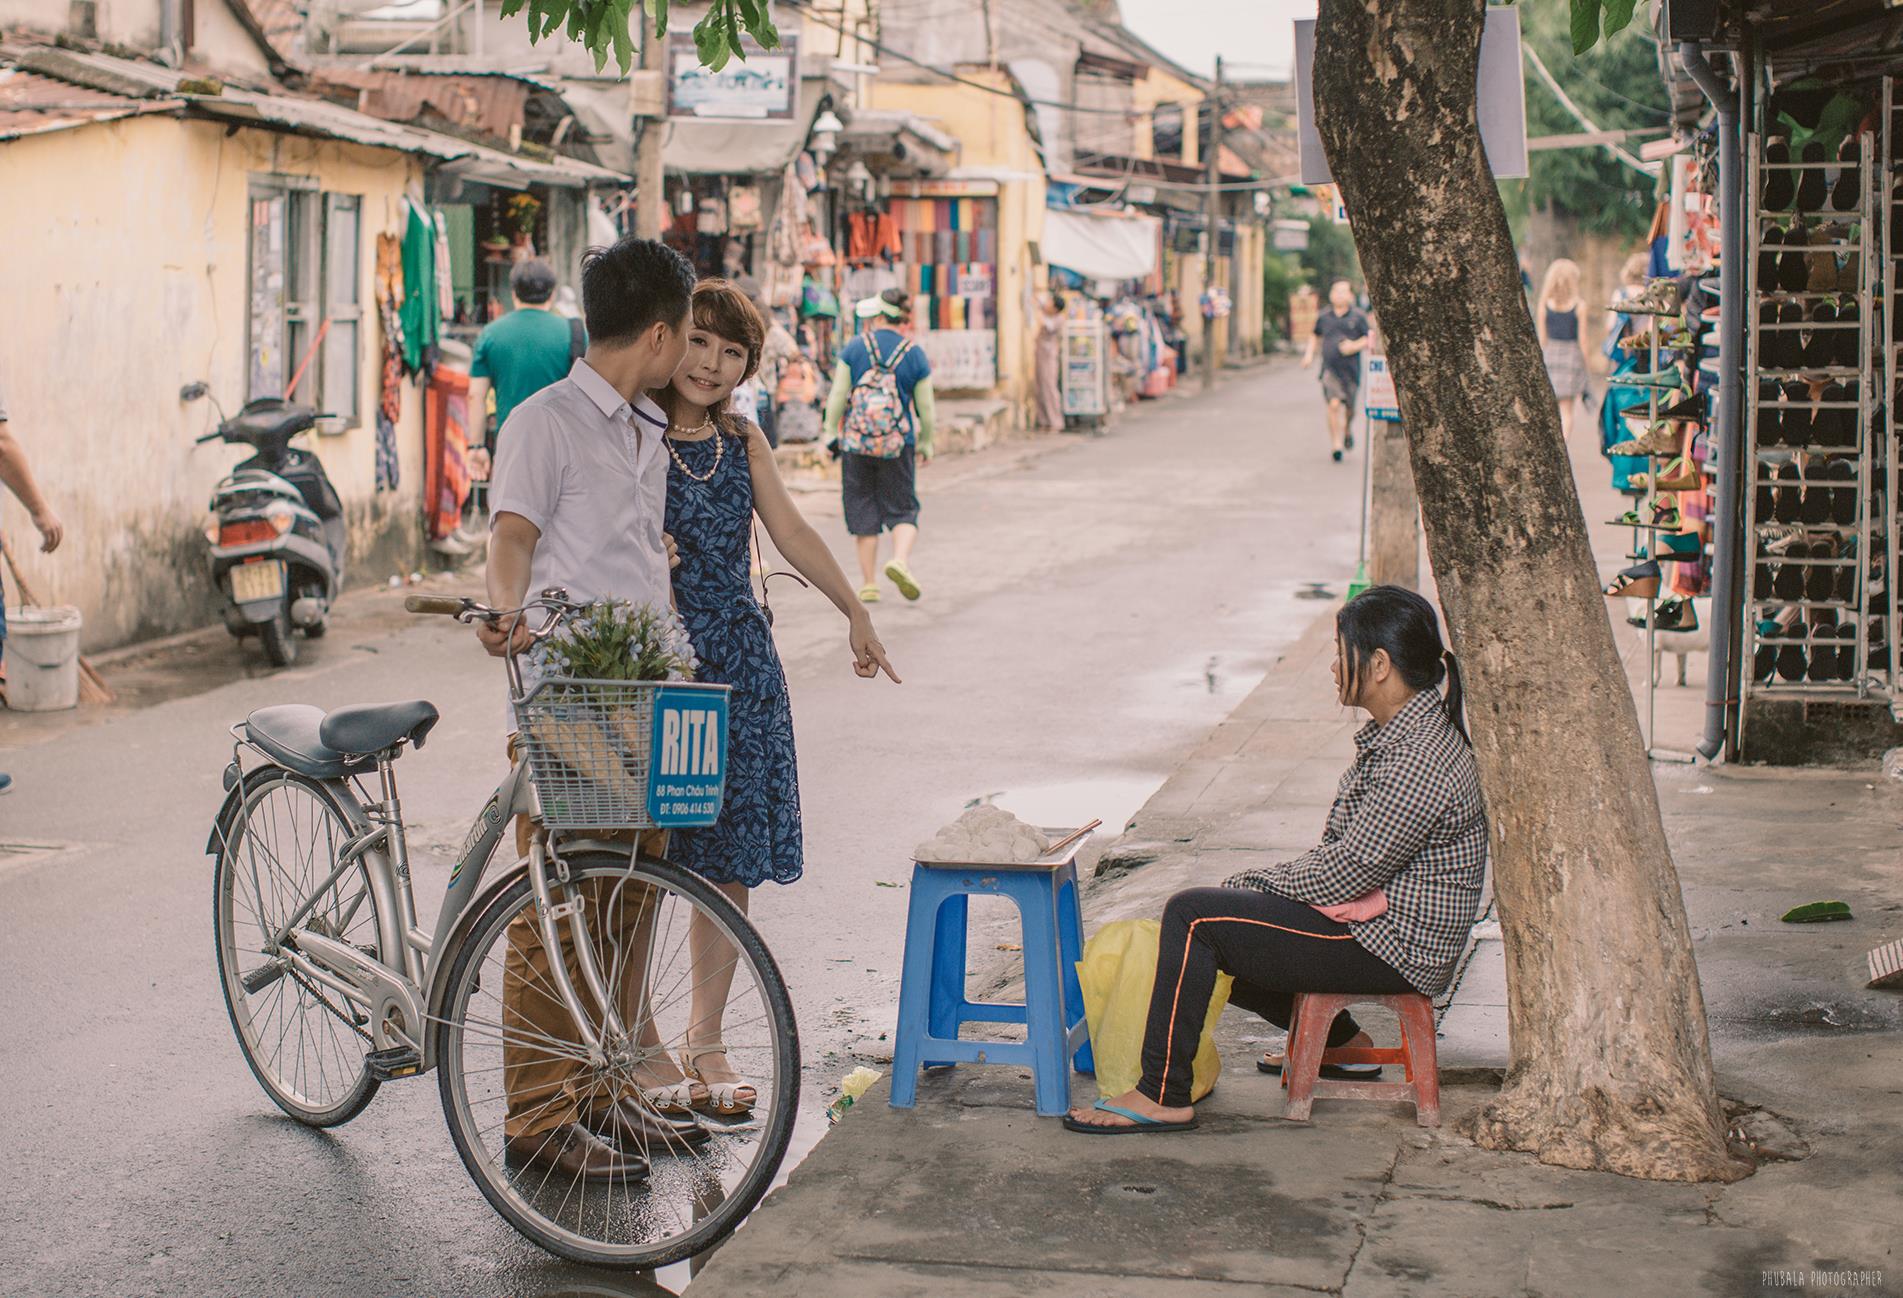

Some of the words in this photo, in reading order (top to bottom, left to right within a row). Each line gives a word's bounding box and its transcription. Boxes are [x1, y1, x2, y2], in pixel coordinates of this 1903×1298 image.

[660, 709, 719, 775] RITA
[656, 784, 666, 797] 88
[667, 784, 685, 796] Phan
[672, 803, 689, 815] 0906
[690, 803, 702, 814] 414
[703, 802, 714, 814] 530
